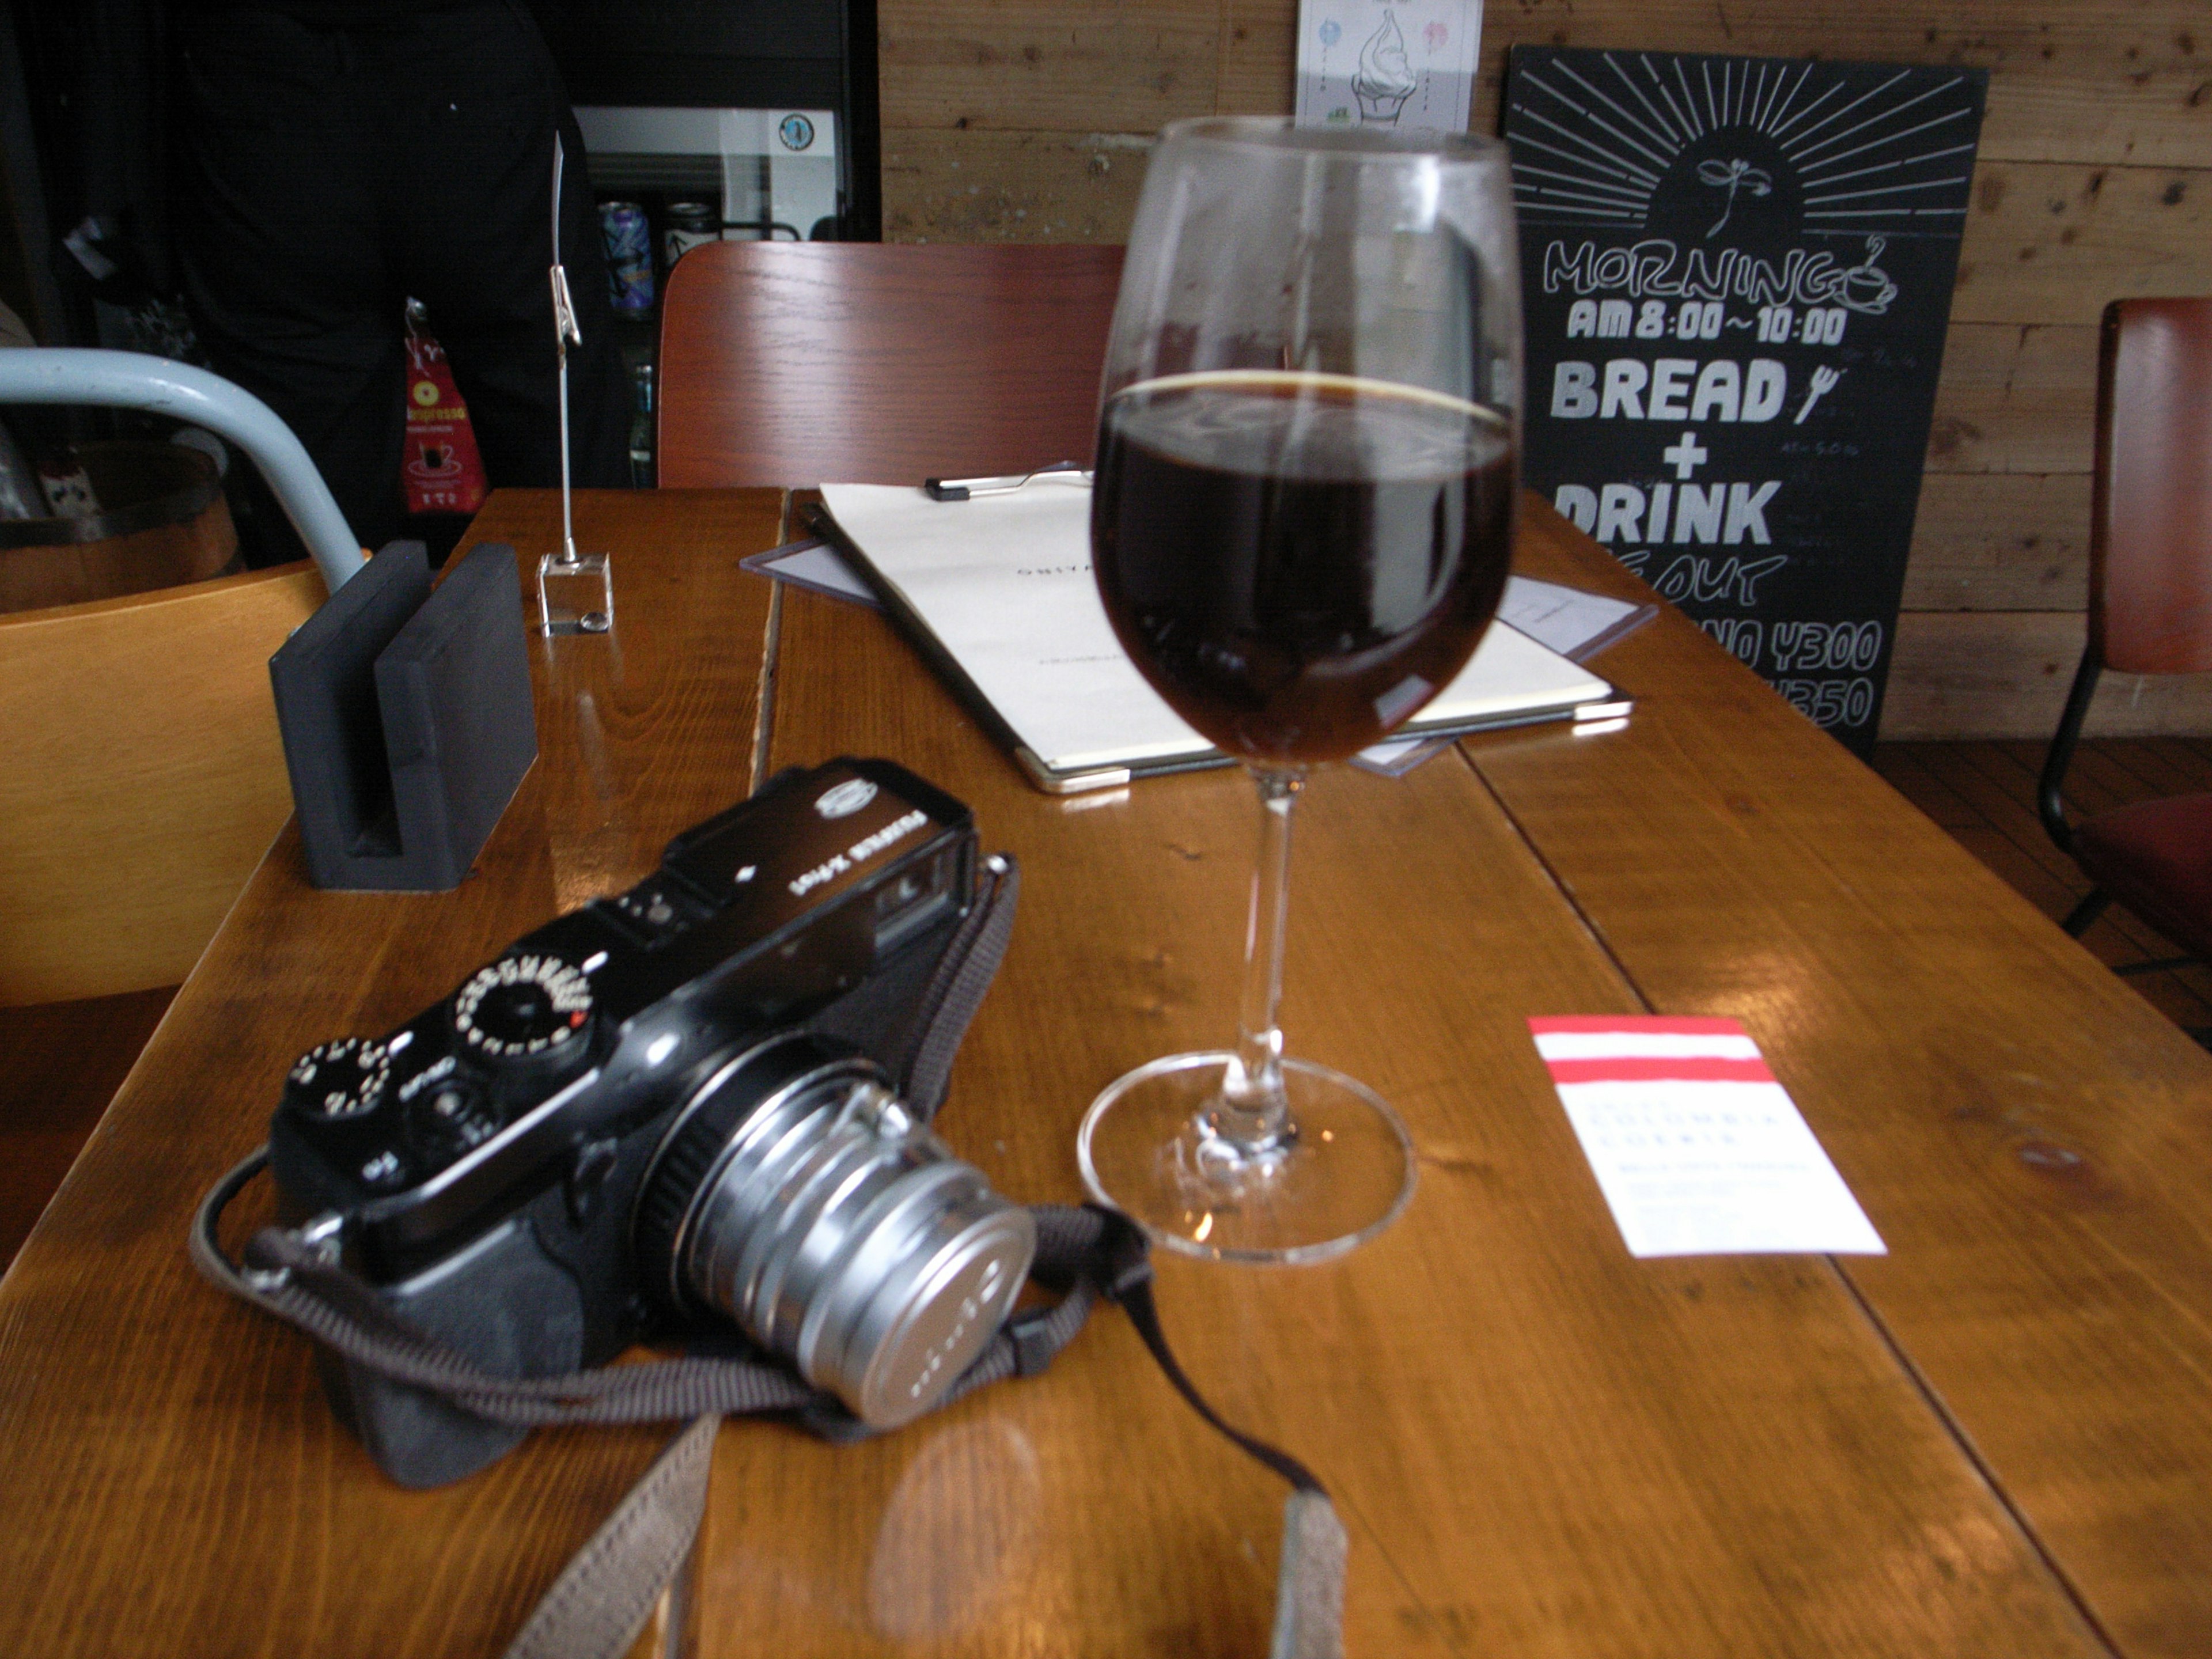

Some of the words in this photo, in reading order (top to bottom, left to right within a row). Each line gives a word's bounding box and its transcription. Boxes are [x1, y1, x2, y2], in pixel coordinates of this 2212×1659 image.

[1544, 239, 1843, 308] MORNING
[1550, 358, 1786, 422] BREAD
[1555, 480, 1782, 545] DRINK
[1766, 677, 1873, 727] 350
